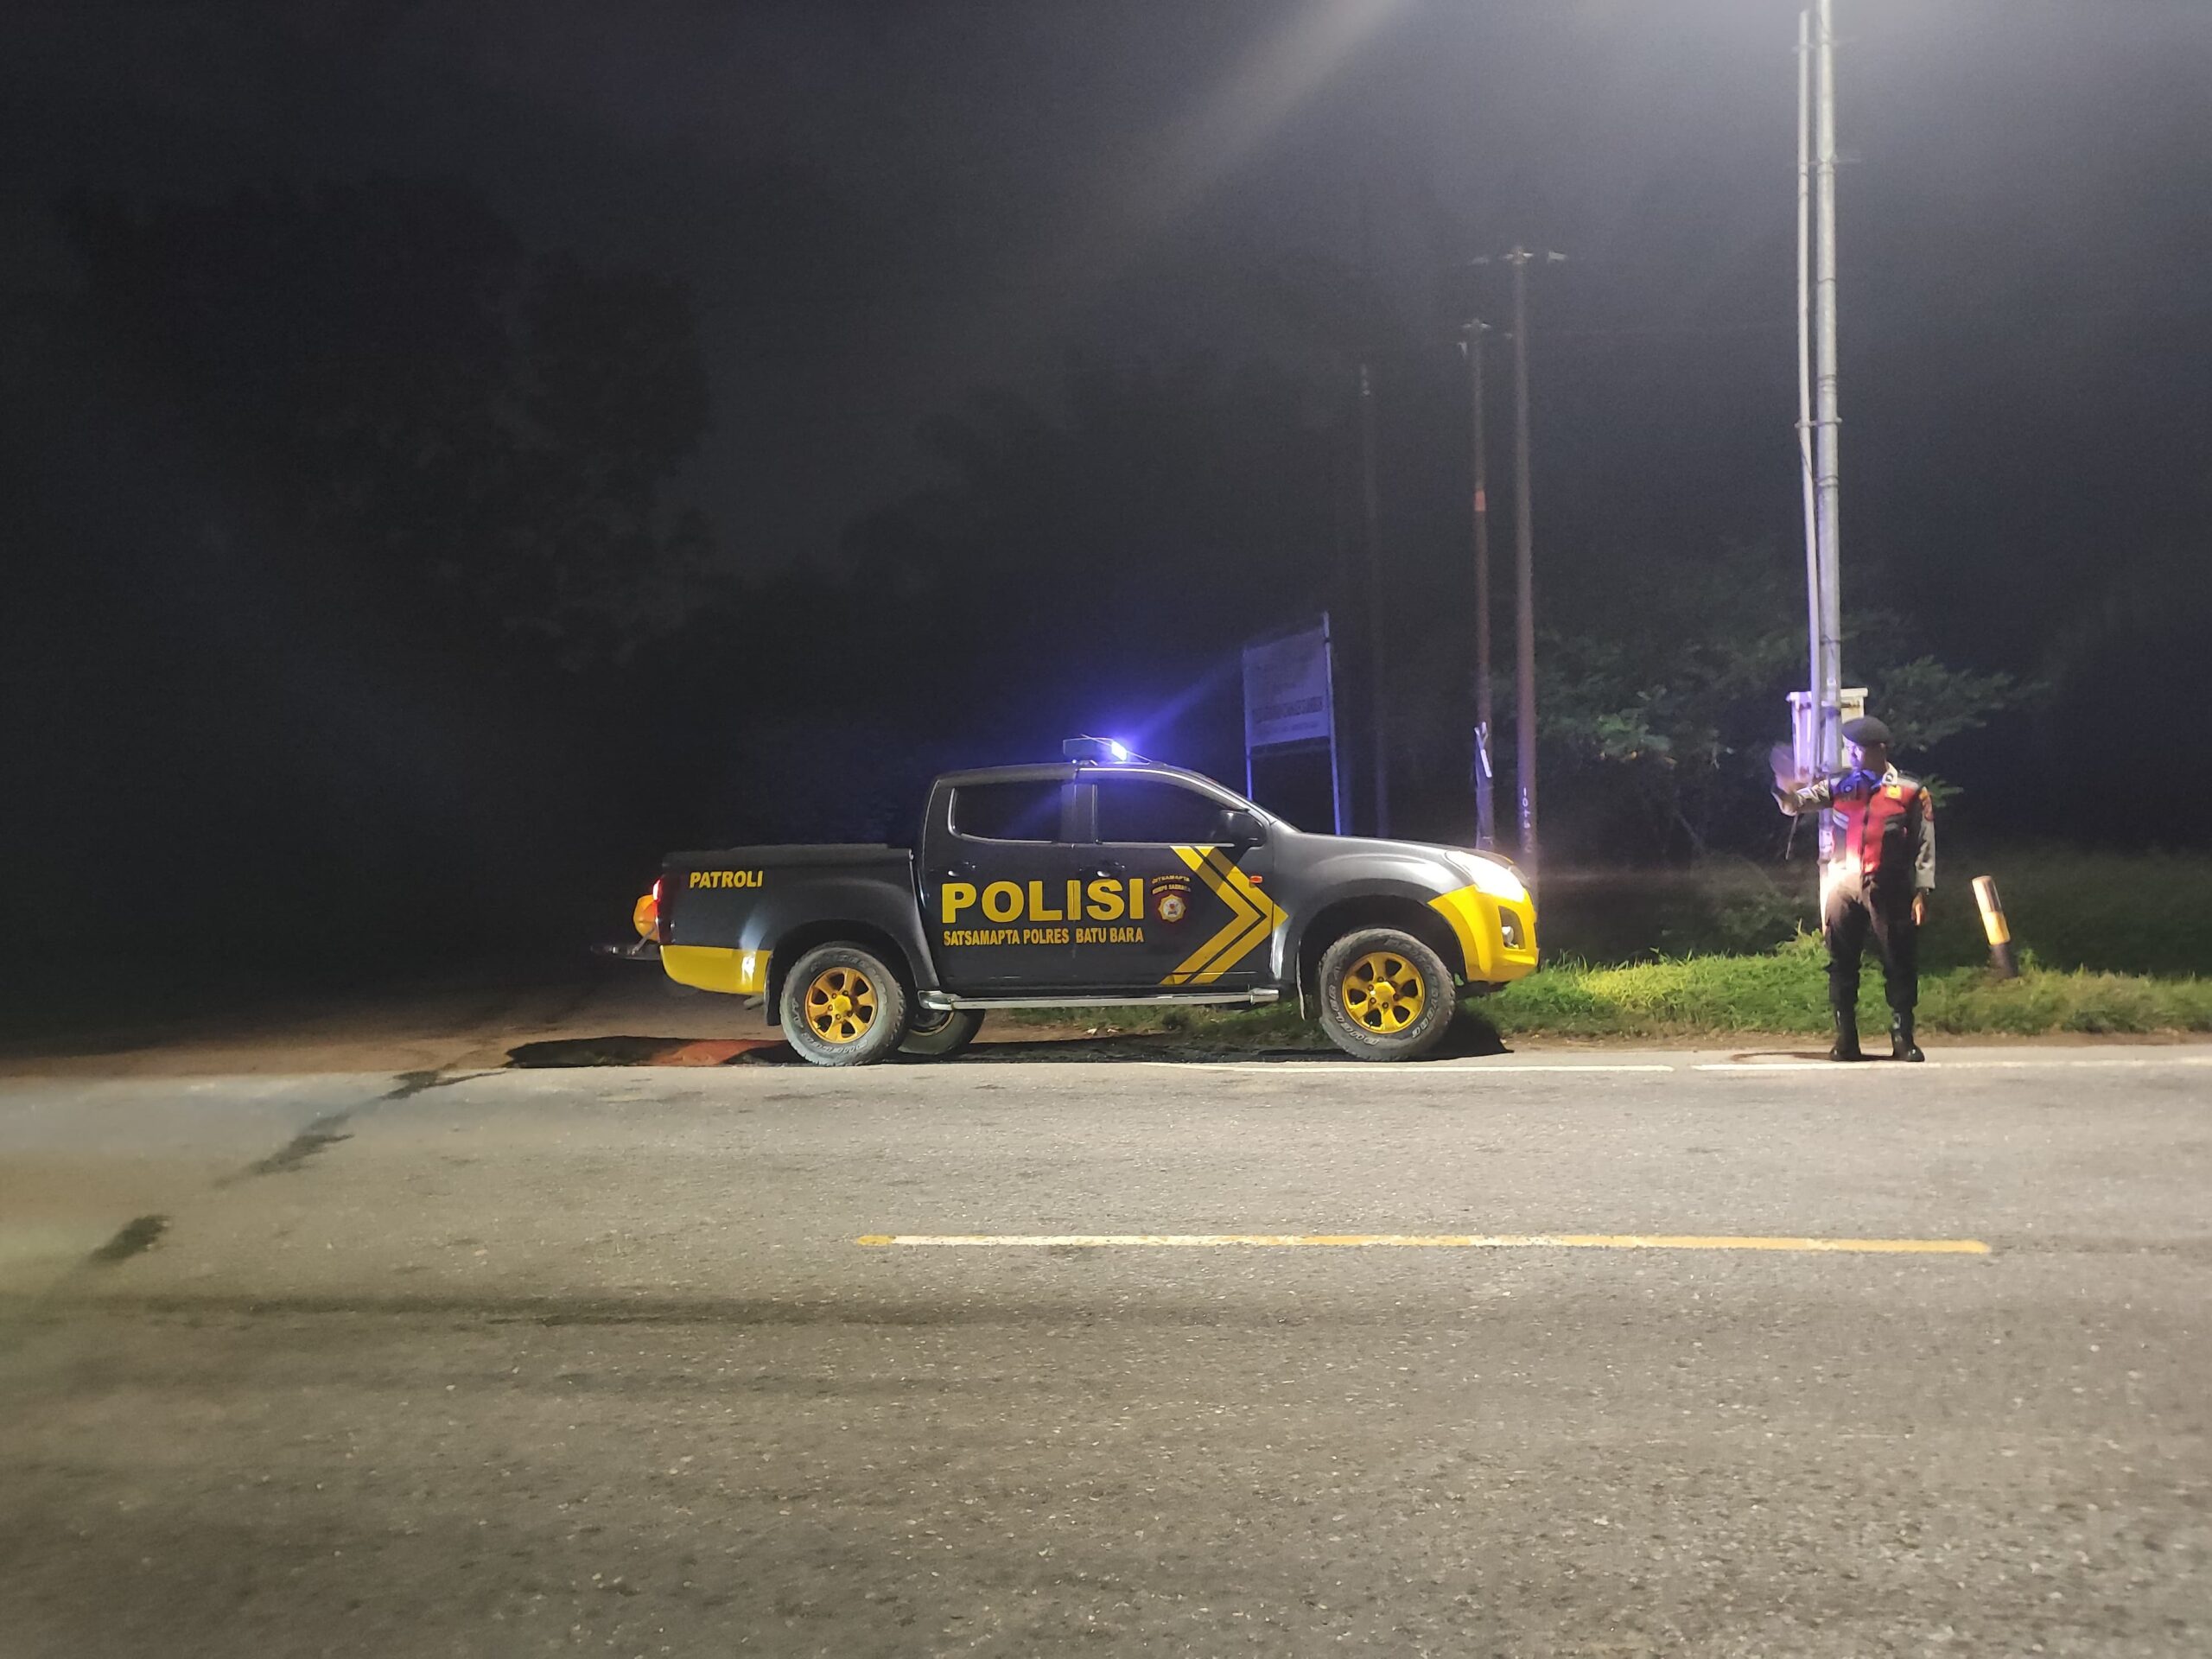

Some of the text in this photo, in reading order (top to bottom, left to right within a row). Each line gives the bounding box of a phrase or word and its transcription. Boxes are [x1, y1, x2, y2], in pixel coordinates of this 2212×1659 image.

[690, 870, 764, 888] PATROLI
[942, 878, 1144, 924] POLISI
[944, 927, 1144, 946] SATSAMAPTA POLRES BATU BARA
